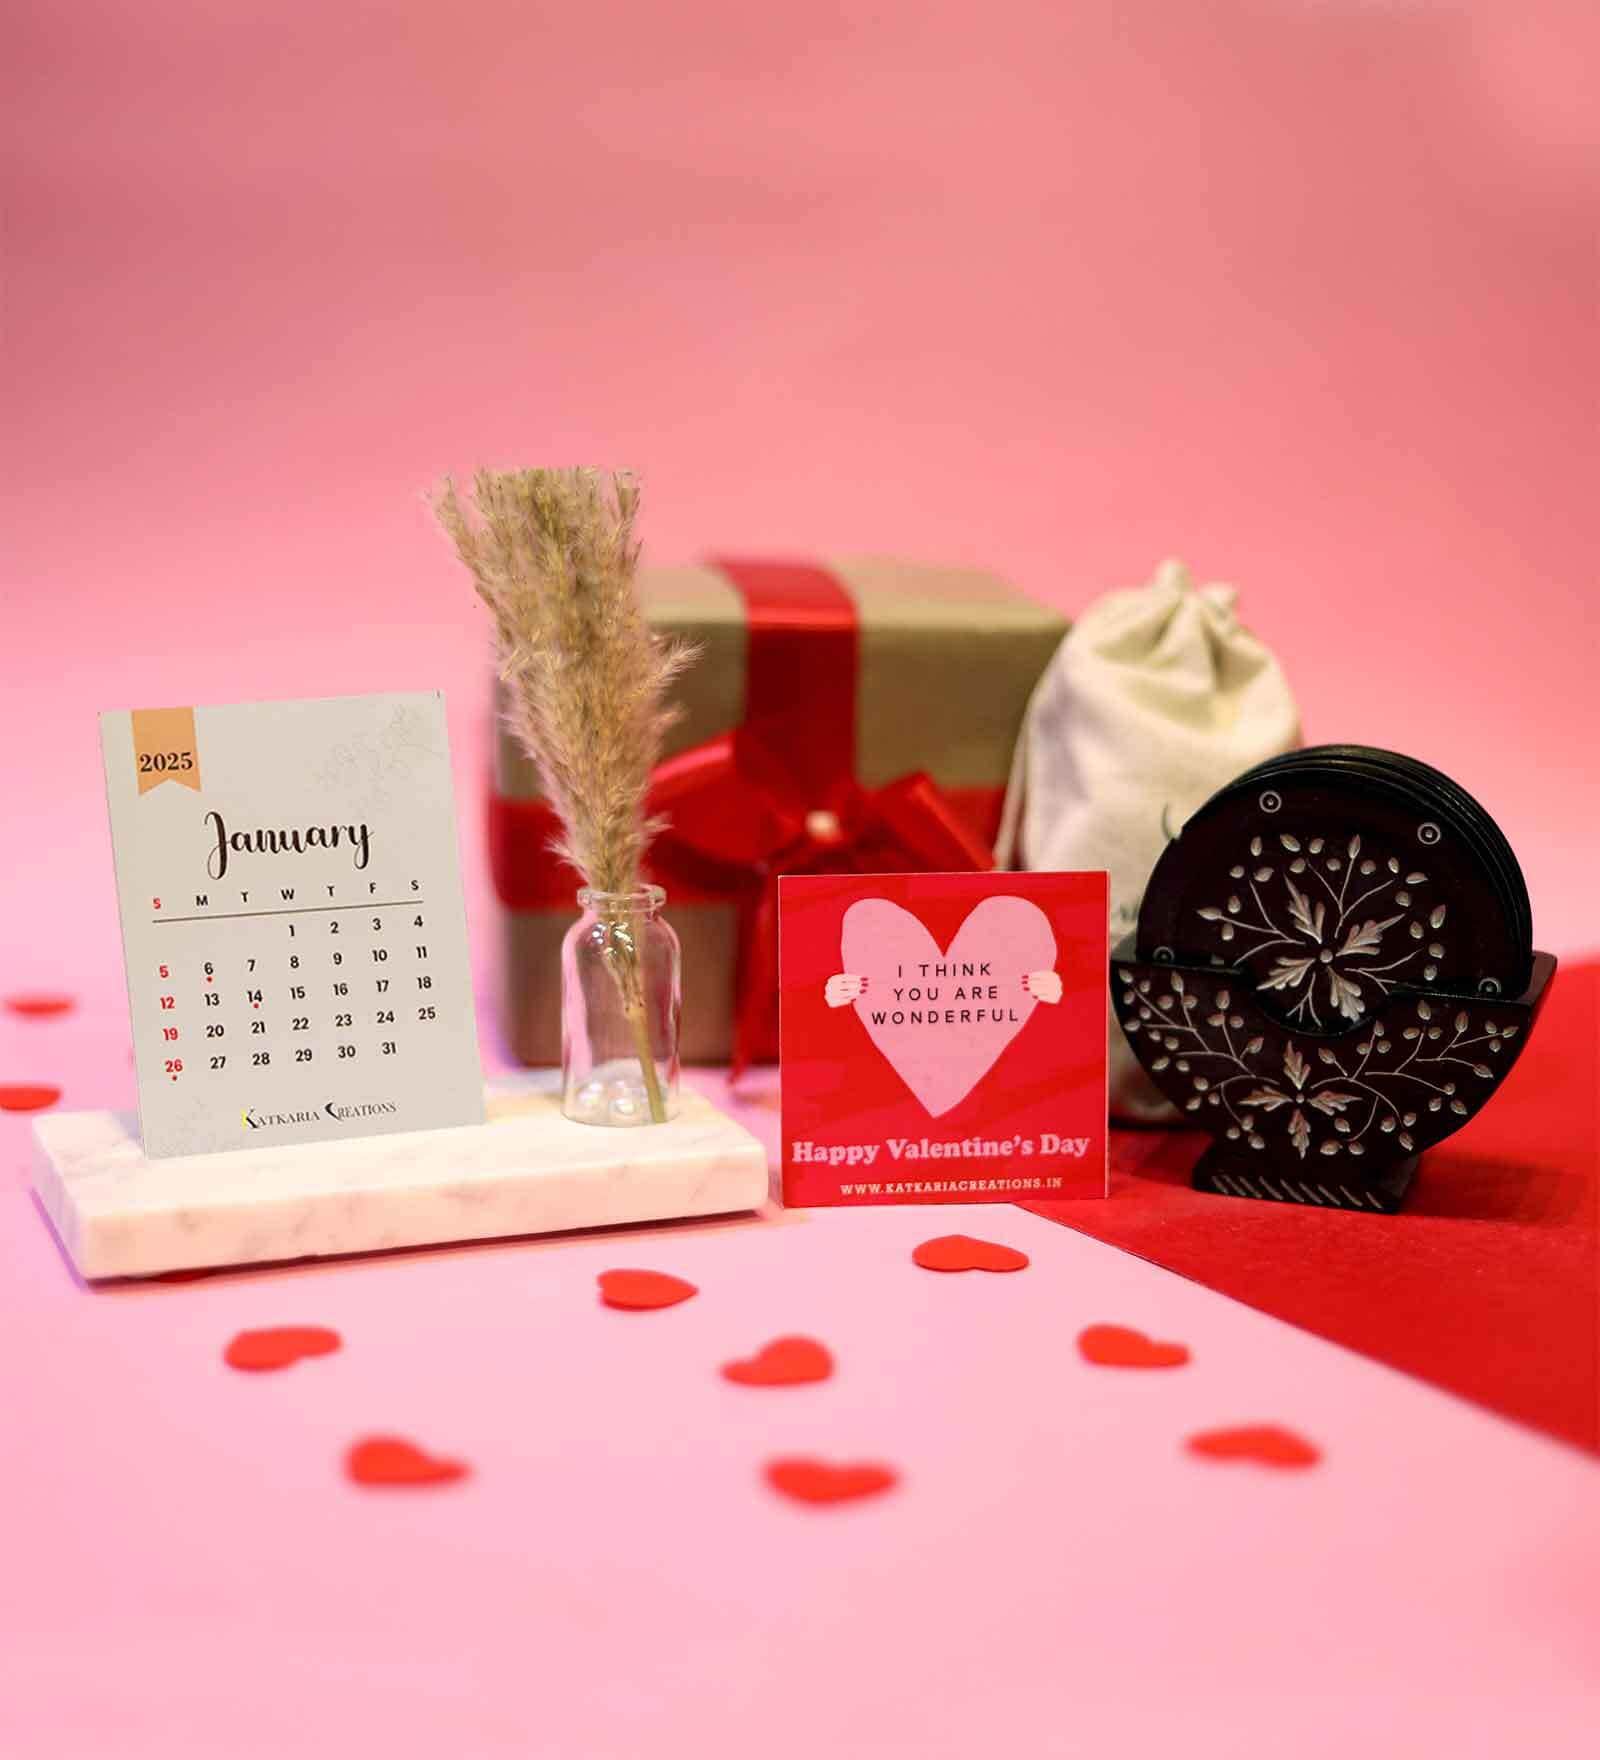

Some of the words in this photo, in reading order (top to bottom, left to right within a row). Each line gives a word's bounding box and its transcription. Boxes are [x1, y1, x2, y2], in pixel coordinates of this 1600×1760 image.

[139, 751, 194, 773] 2025
[204, 811, 374, 881] January
[152, 897, 162, 910] S
[195, 894, 209, 907] M
[240, 891, 249, 903] T
[280, 888, 295, 901] W
[326, 885, 335, 897] T
[369, 881, 377, 894] F
[410, 879, 420, 891] S
[288, 924, 295, 937] 1
[330, 921, 339, 934] 2
[372, 917, 382, 932] 3
[413, 915, 424, 928] 4
[159, 965, 169, 979] 5
[203, 961, 214, 976] 6
[247, 958, 256, 972] 7
[289, 955, 300, 969] 8
[332, 952, 343, 966] 9
[371, 948, 388, 963] 10
[415, 945, 428, 959] 11
[918, 962, 991, 977] THINK
[159, 996, 176, 1010] 12
[204, 992, 220, 1007] 13
[247, 989, 263, 1004] 14
[290, 985, 306, 1000] 15
[333, 982, 349, 996] 16
[375, 979, 389, 993] 17
[416, 975, 432, 990] 18
[893, 987, 939, 1002] YOU
[954, 985, 998, 1001] ARE
[162, 1027, 179, 1041] 19
[205, 1024, 225, 1039] 20
[251, 1020, 266, 1034] 21
[292, 1016, 310, 1031] 22
[335, 1013, 353, 1028] 23
[376, 1010, 395, 1024] 24
[417, 1006, 436, 1021] 25
[871, 1008, 1019, 1025] WONDERFUL
[164, 1058, 184, 1073] 26
[209, 1055, 227, 1070] 27
[252, 1051, 271, 1066] 28
[295, 1048, 313, 1063] 29
[337, 1045, 356, 1059] 30
[381, 1041, 397, 1055] 31
[791, 1141, 881, 1166] Happy
[885, 1134, 1034, 1160] Valentine's
[1039, 1133, 1090, 1158] Day
[839, 1177, 1062, 1195] WWW.KATKARIACREATIONS.IN
